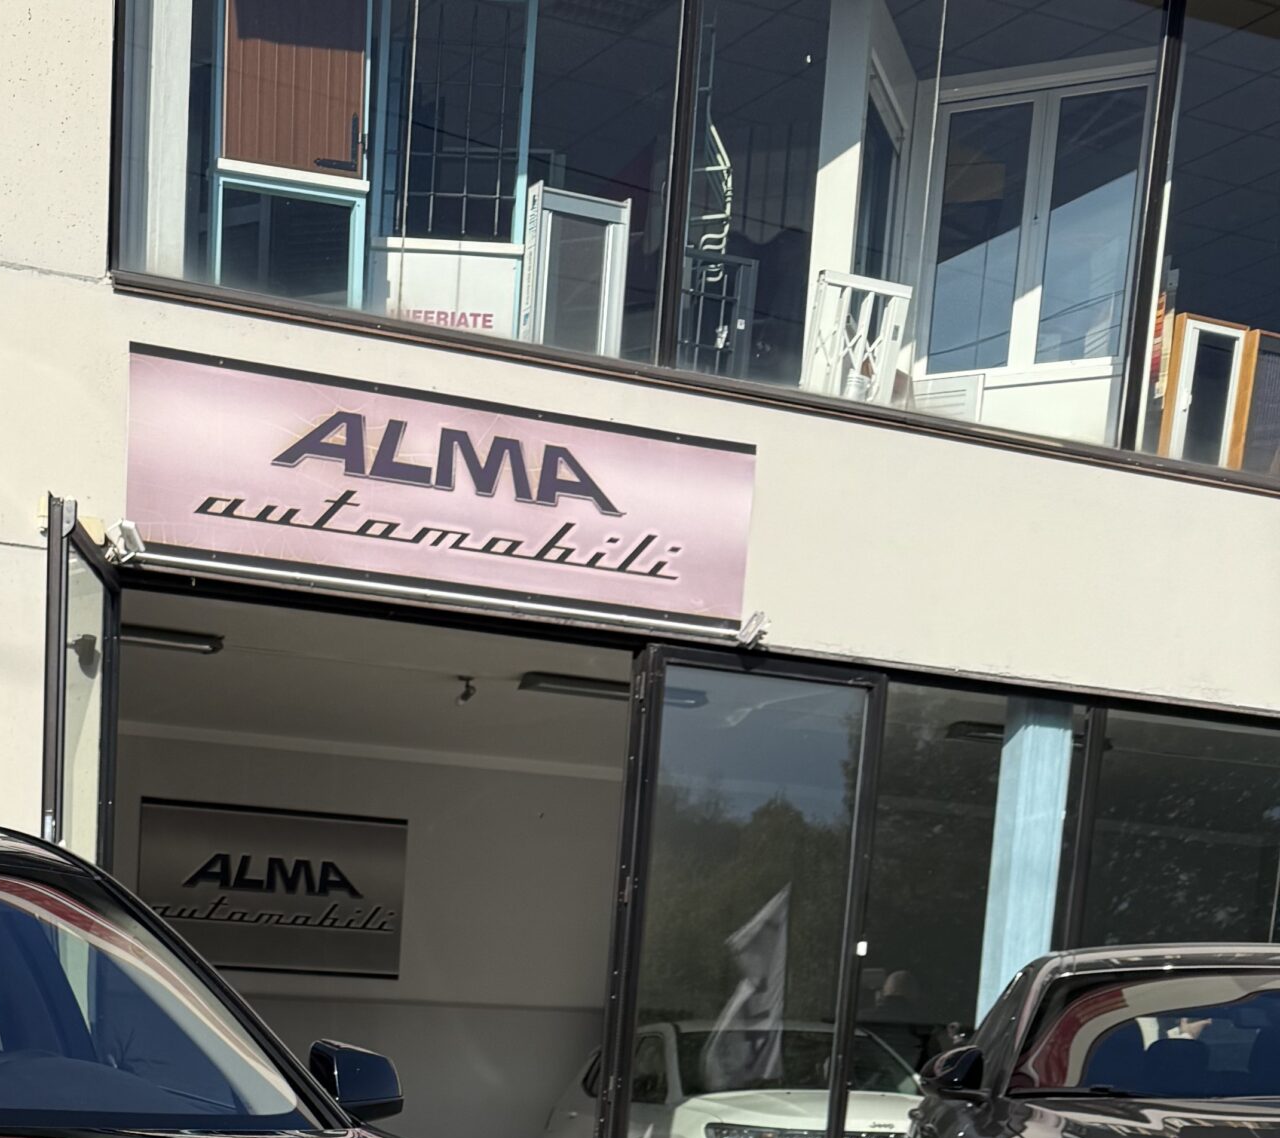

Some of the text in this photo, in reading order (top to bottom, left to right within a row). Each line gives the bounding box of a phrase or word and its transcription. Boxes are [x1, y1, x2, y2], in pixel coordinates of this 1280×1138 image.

[271, 411, 626, 518] ALMA
[193, 489, 679, 581] automobili
[182, 853, 363, 899] ALMA
[151, 896, 395, 931] automobili
